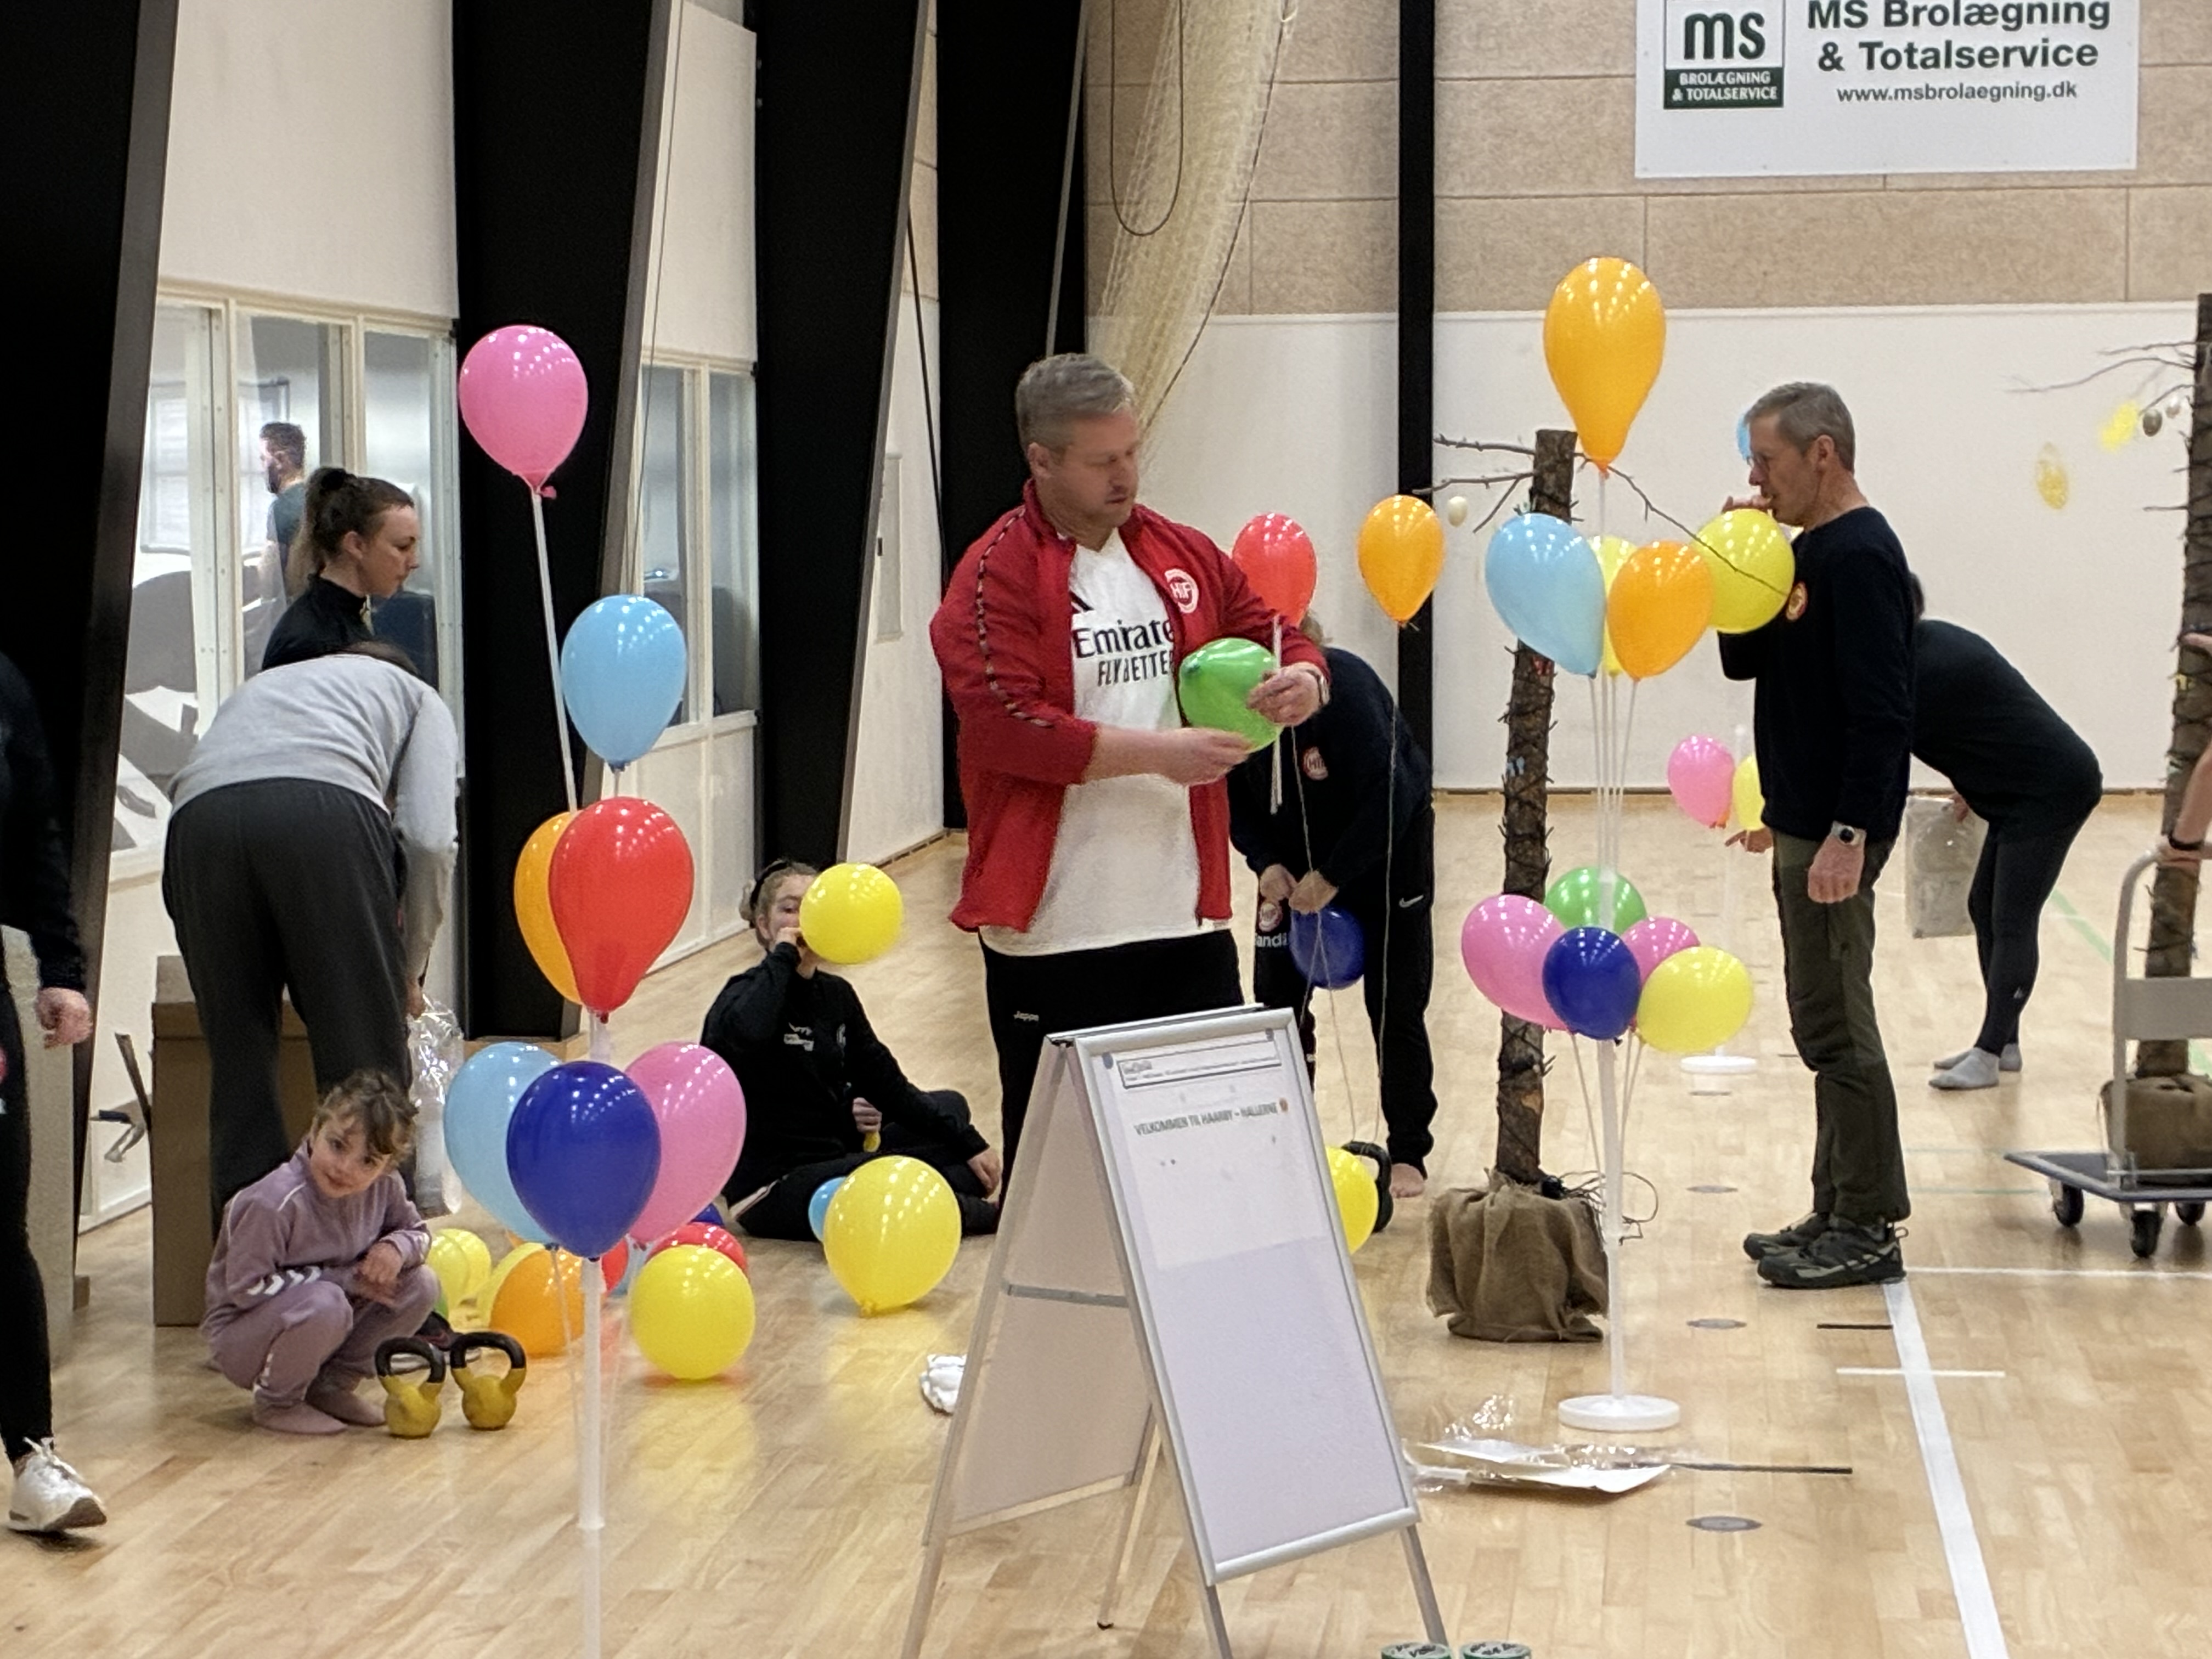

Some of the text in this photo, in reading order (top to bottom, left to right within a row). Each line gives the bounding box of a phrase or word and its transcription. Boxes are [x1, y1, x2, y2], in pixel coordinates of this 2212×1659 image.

[1808, 0, 2110, 32] MS Brolægning
[1683, 12, 1765, 60] ms
[1818, 38, 2099, 72] & Totalservice
[1679, 71, 1771, 86] BROLÆGNING
[1836, 81, 2078, 103] www.msbrolaegning.dk
[1672, 86, 1778, 101] & TOTALSERVICE
